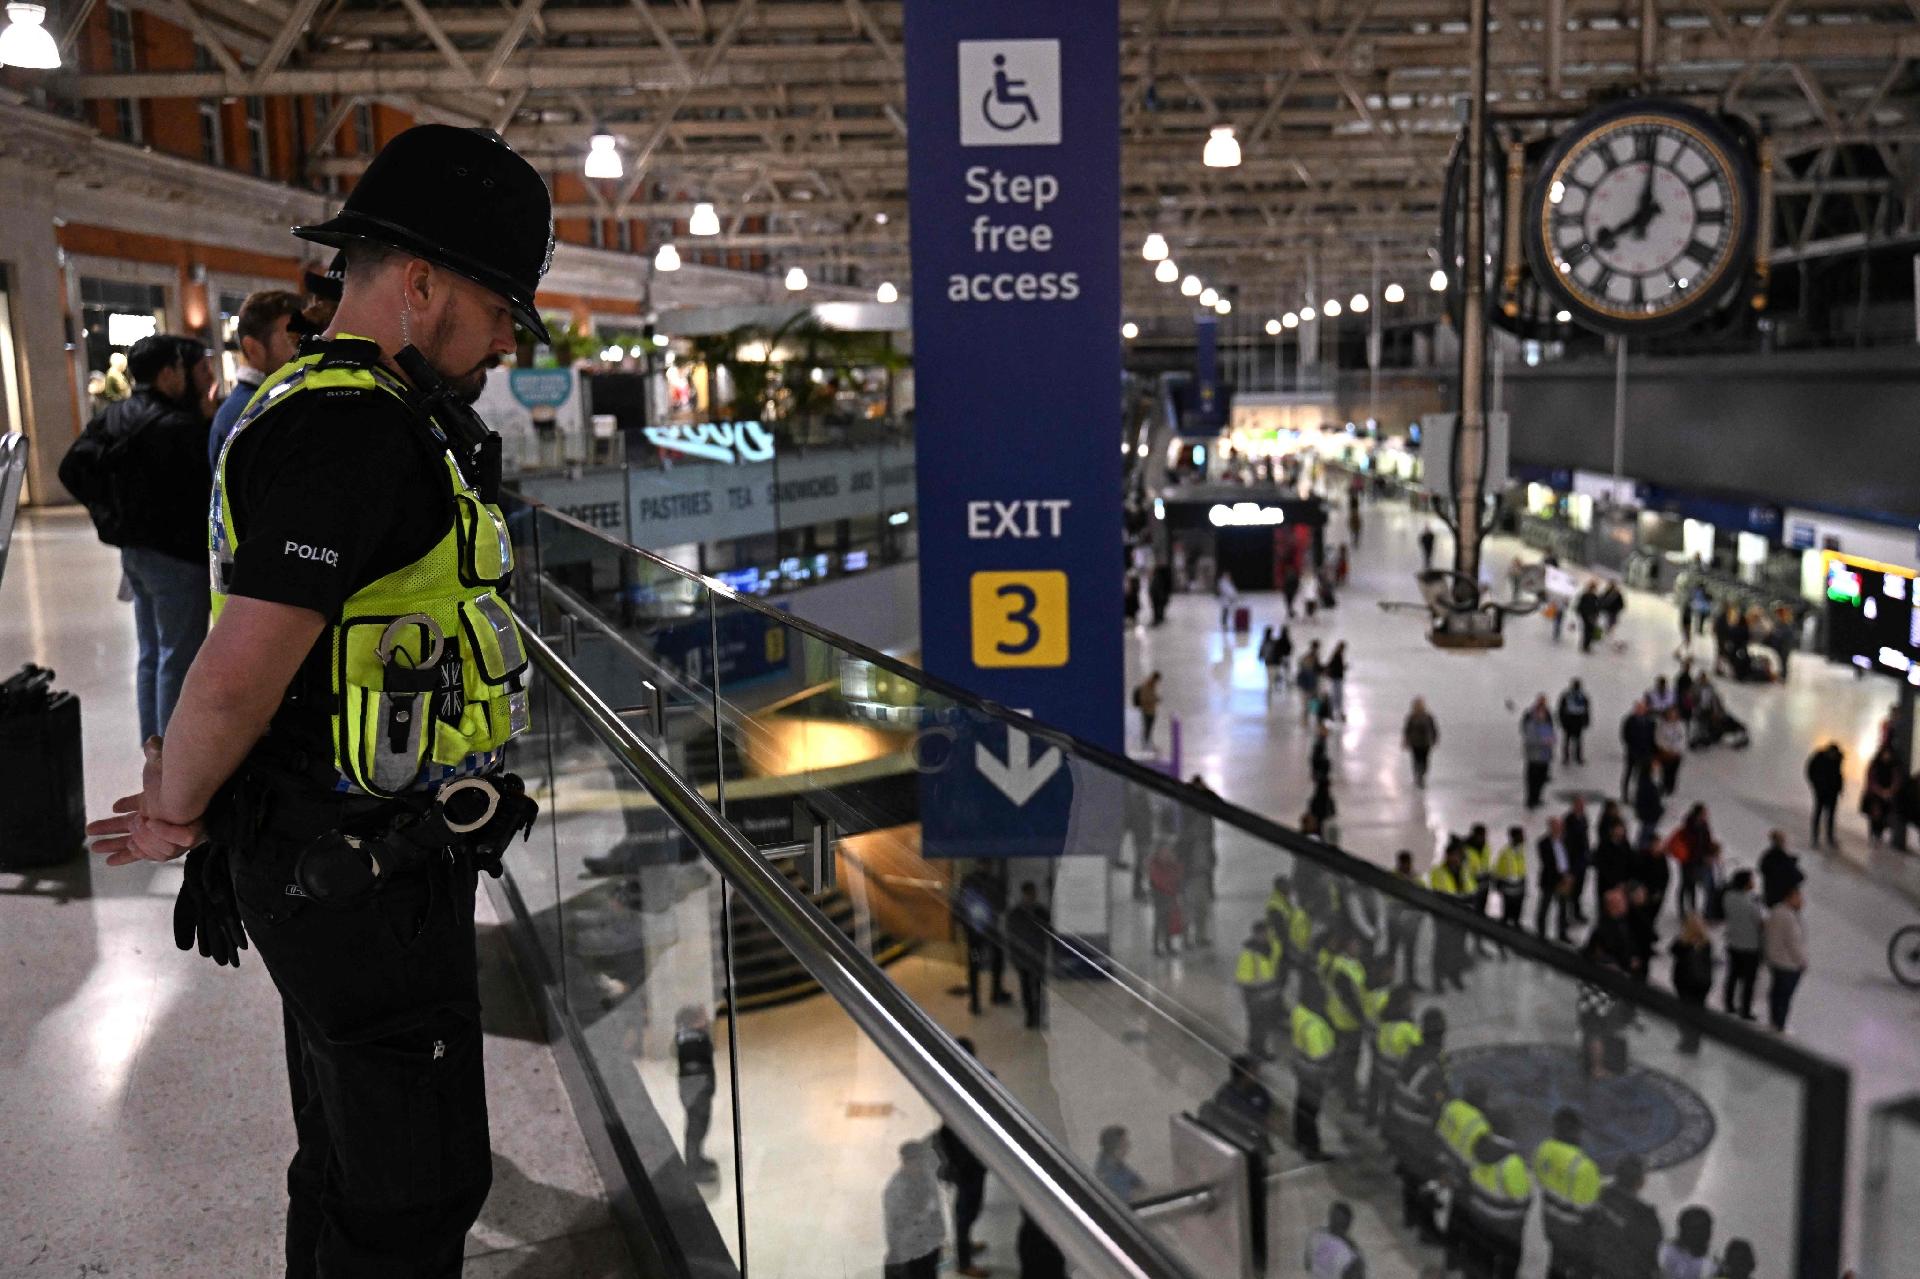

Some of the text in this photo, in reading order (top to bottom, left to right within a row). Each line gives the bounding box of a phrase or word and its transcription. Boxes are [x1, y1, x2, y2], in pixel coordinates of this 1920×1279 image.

[966, 165, 1060, 211] Step
[972, 215, 1053, 252] free
[947, 271, 1080, 301] access
[639, 489, 713, 523] PASTRIES
[967, 499, 1072, 538] EXIT
[996, 582, 1041, 655] 3
